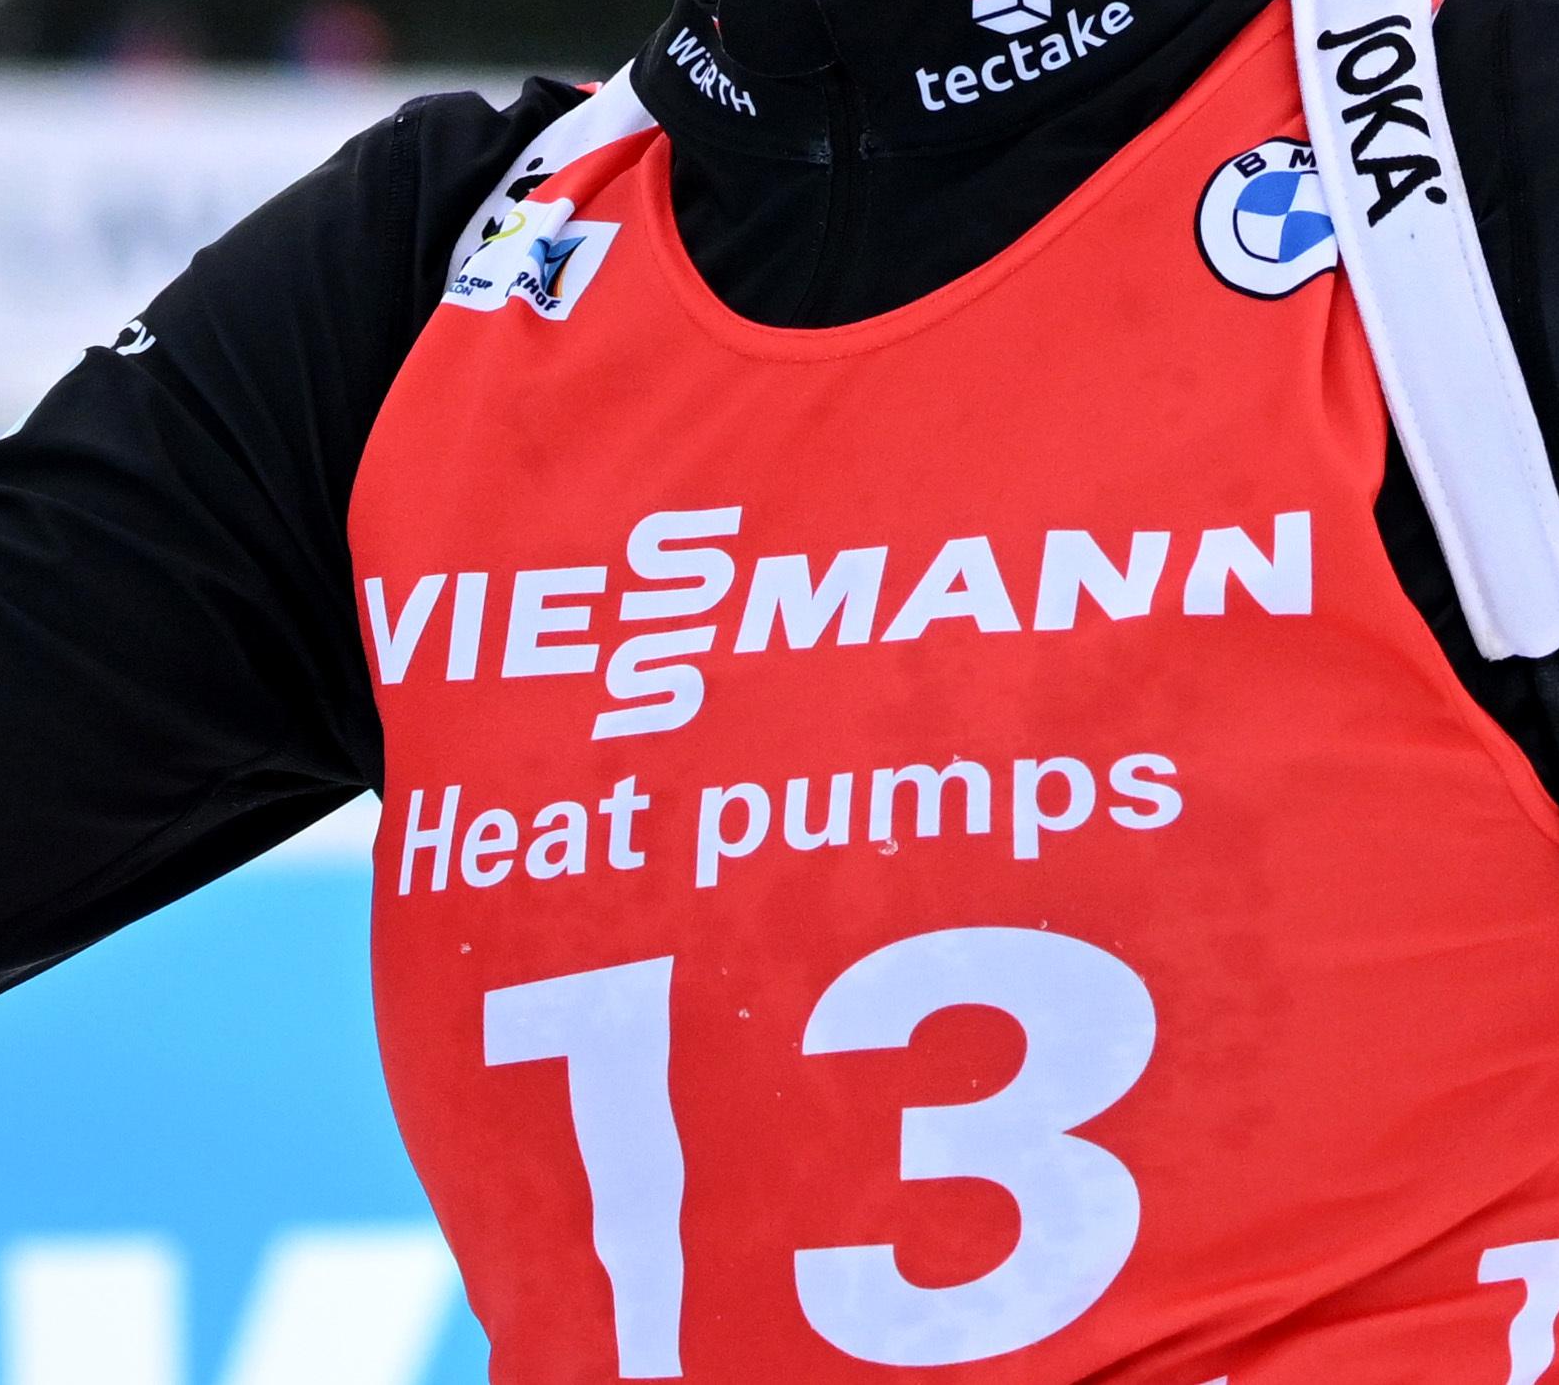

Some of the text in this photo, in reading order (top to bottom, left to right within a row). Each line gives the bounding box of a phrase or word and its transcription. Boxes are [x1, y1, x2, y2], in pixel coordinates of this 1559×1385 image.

[666, 26, 757, 117] WÜRTH
[915, 0, 1134, 112] tectake
[1232, 148, 1318, 179] BM
[363, 505, 1314, 742] VIESSMANN
[396, 750, 1185, 897] Heat pumps
[483, 925, 1159, 1381] 13
